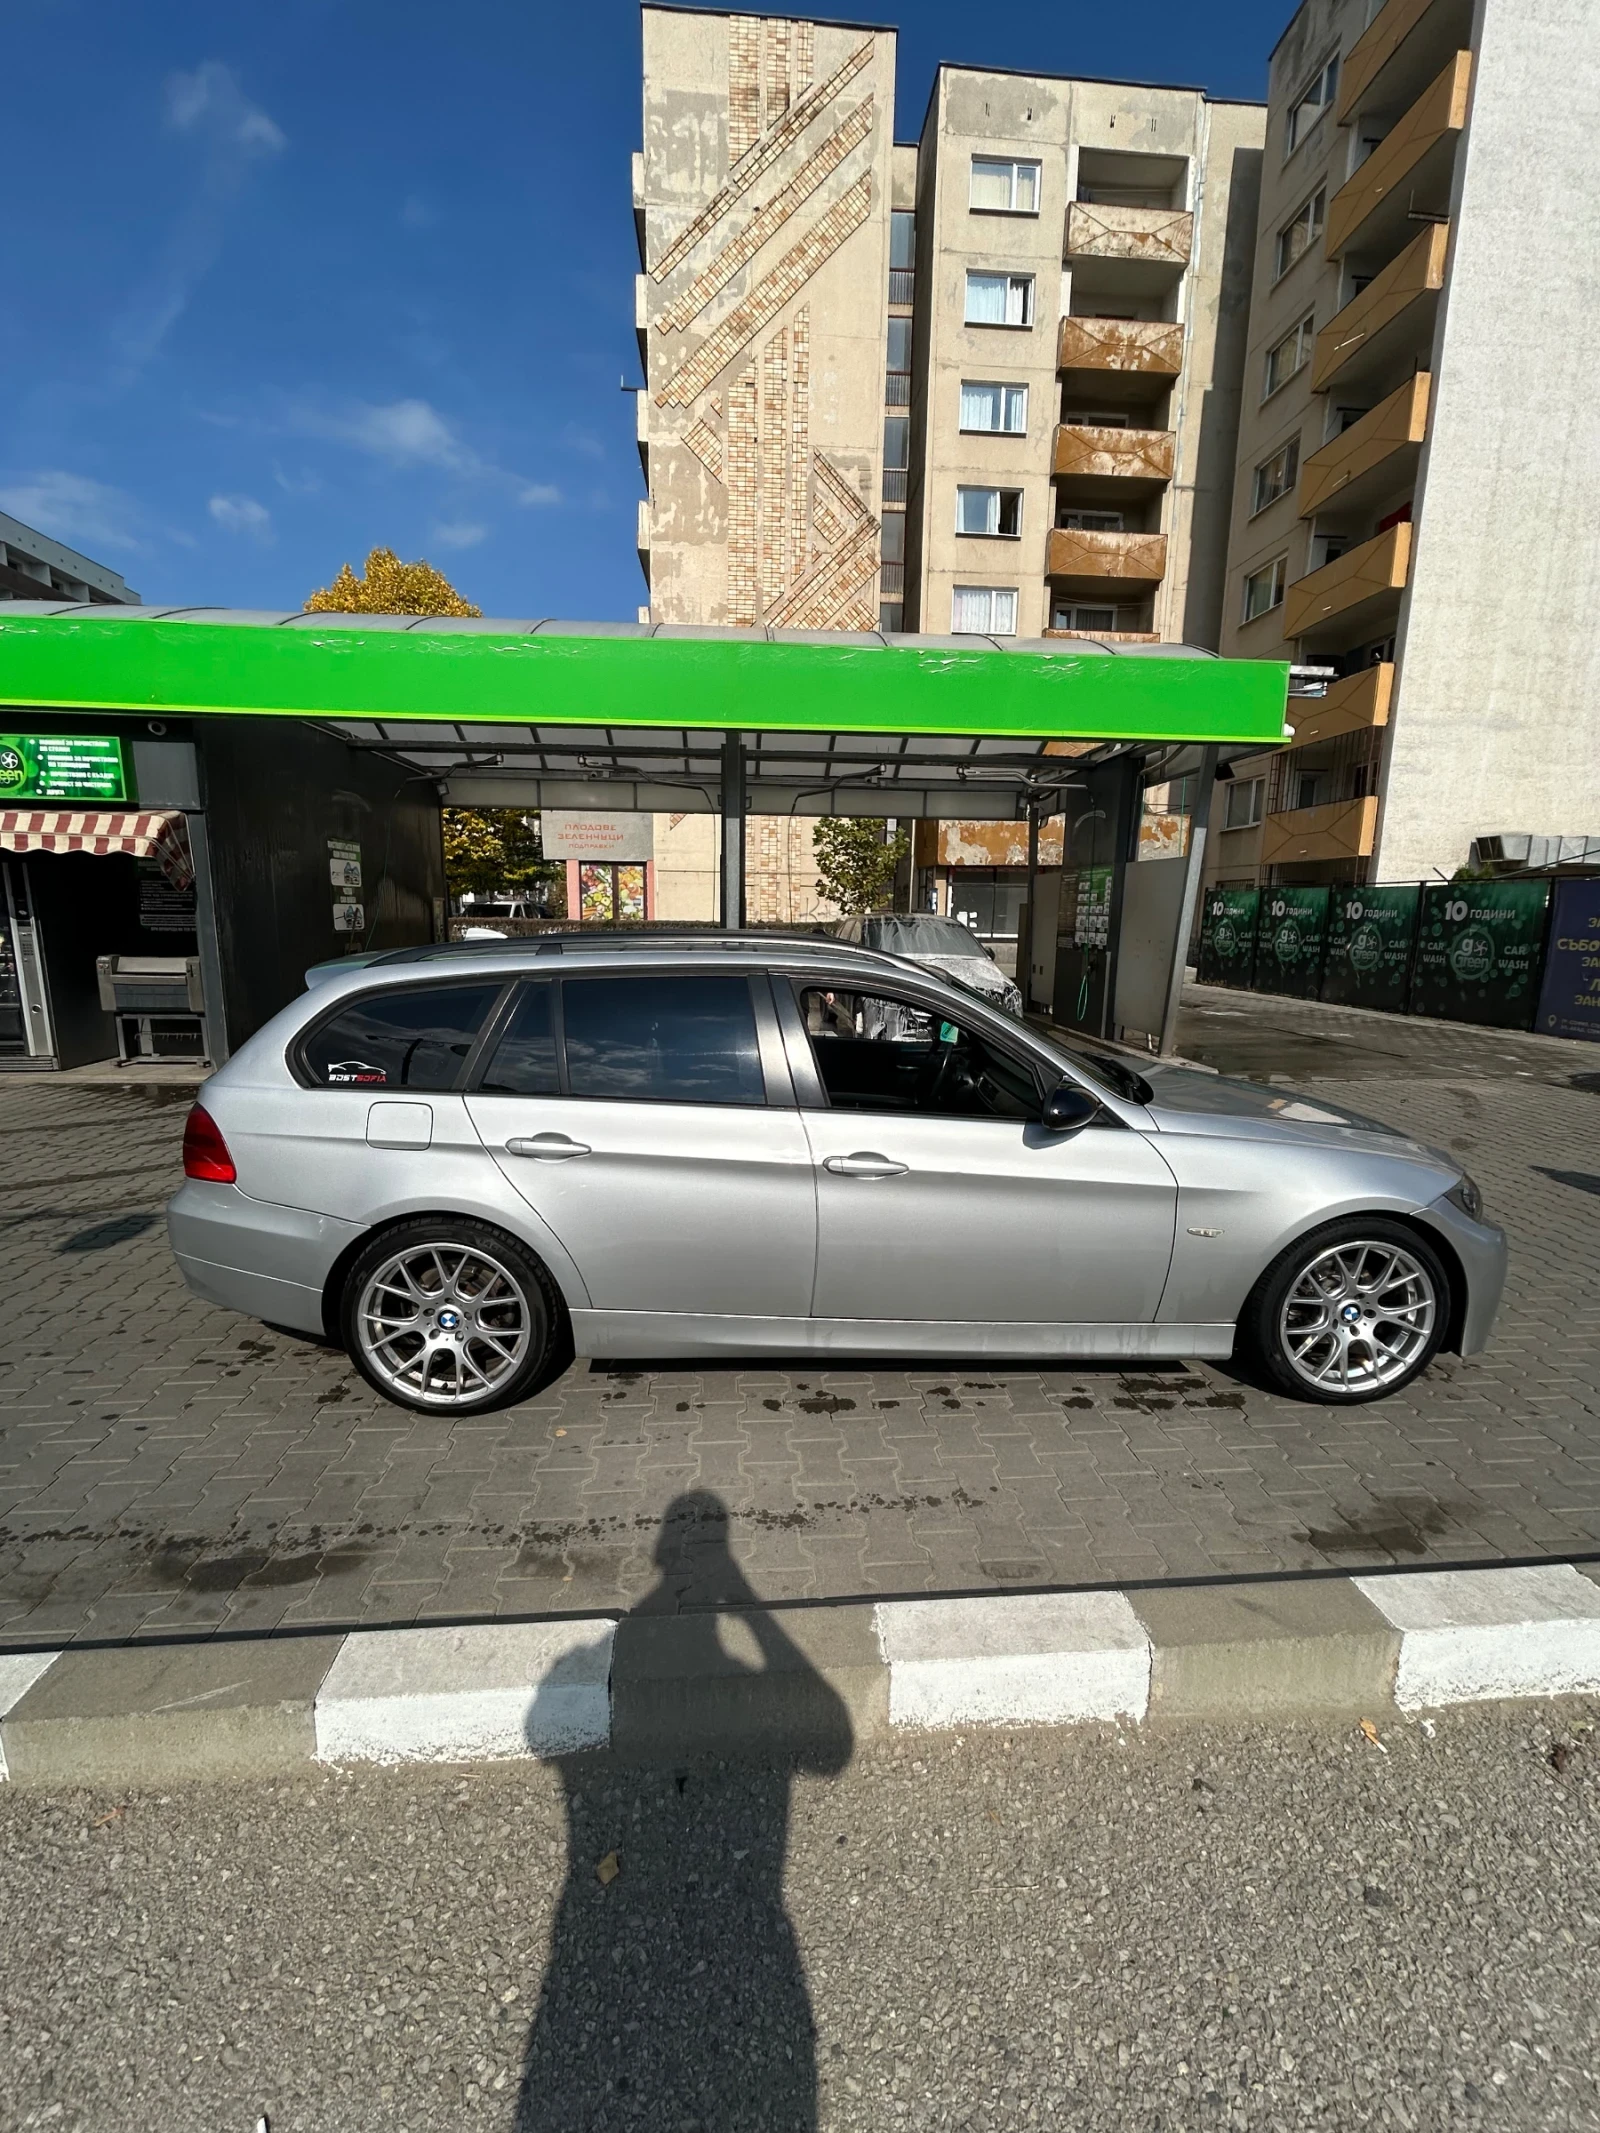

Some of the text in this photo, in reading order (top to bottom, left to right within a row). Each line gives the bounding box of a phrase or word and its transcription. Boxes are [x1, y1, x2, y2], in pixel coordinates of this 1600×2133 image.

[564, 823, 616, 831] ПЛОДОВЕ
[557, 833, 624, 841] ЗЕЛЕНЧУЦИ
[1213, 901, 1224, 916] 10
[1271, 900, 1286, 917] 10
[1346, 901, 1363, 919] 10
[1444, 900, 1468, 921] 10
[1303, 945, 1320, 953] WASH
[1388, 940, 1406, 948] CAR
[1427, 941, 1444, 951] CAR
[1504, 945, 1526, 955] CAR
[1384, 951, 1407, 960] WASH
[1423, 953, 1446, 963] WASH
[1498, 959, 1529, 970] WASH
